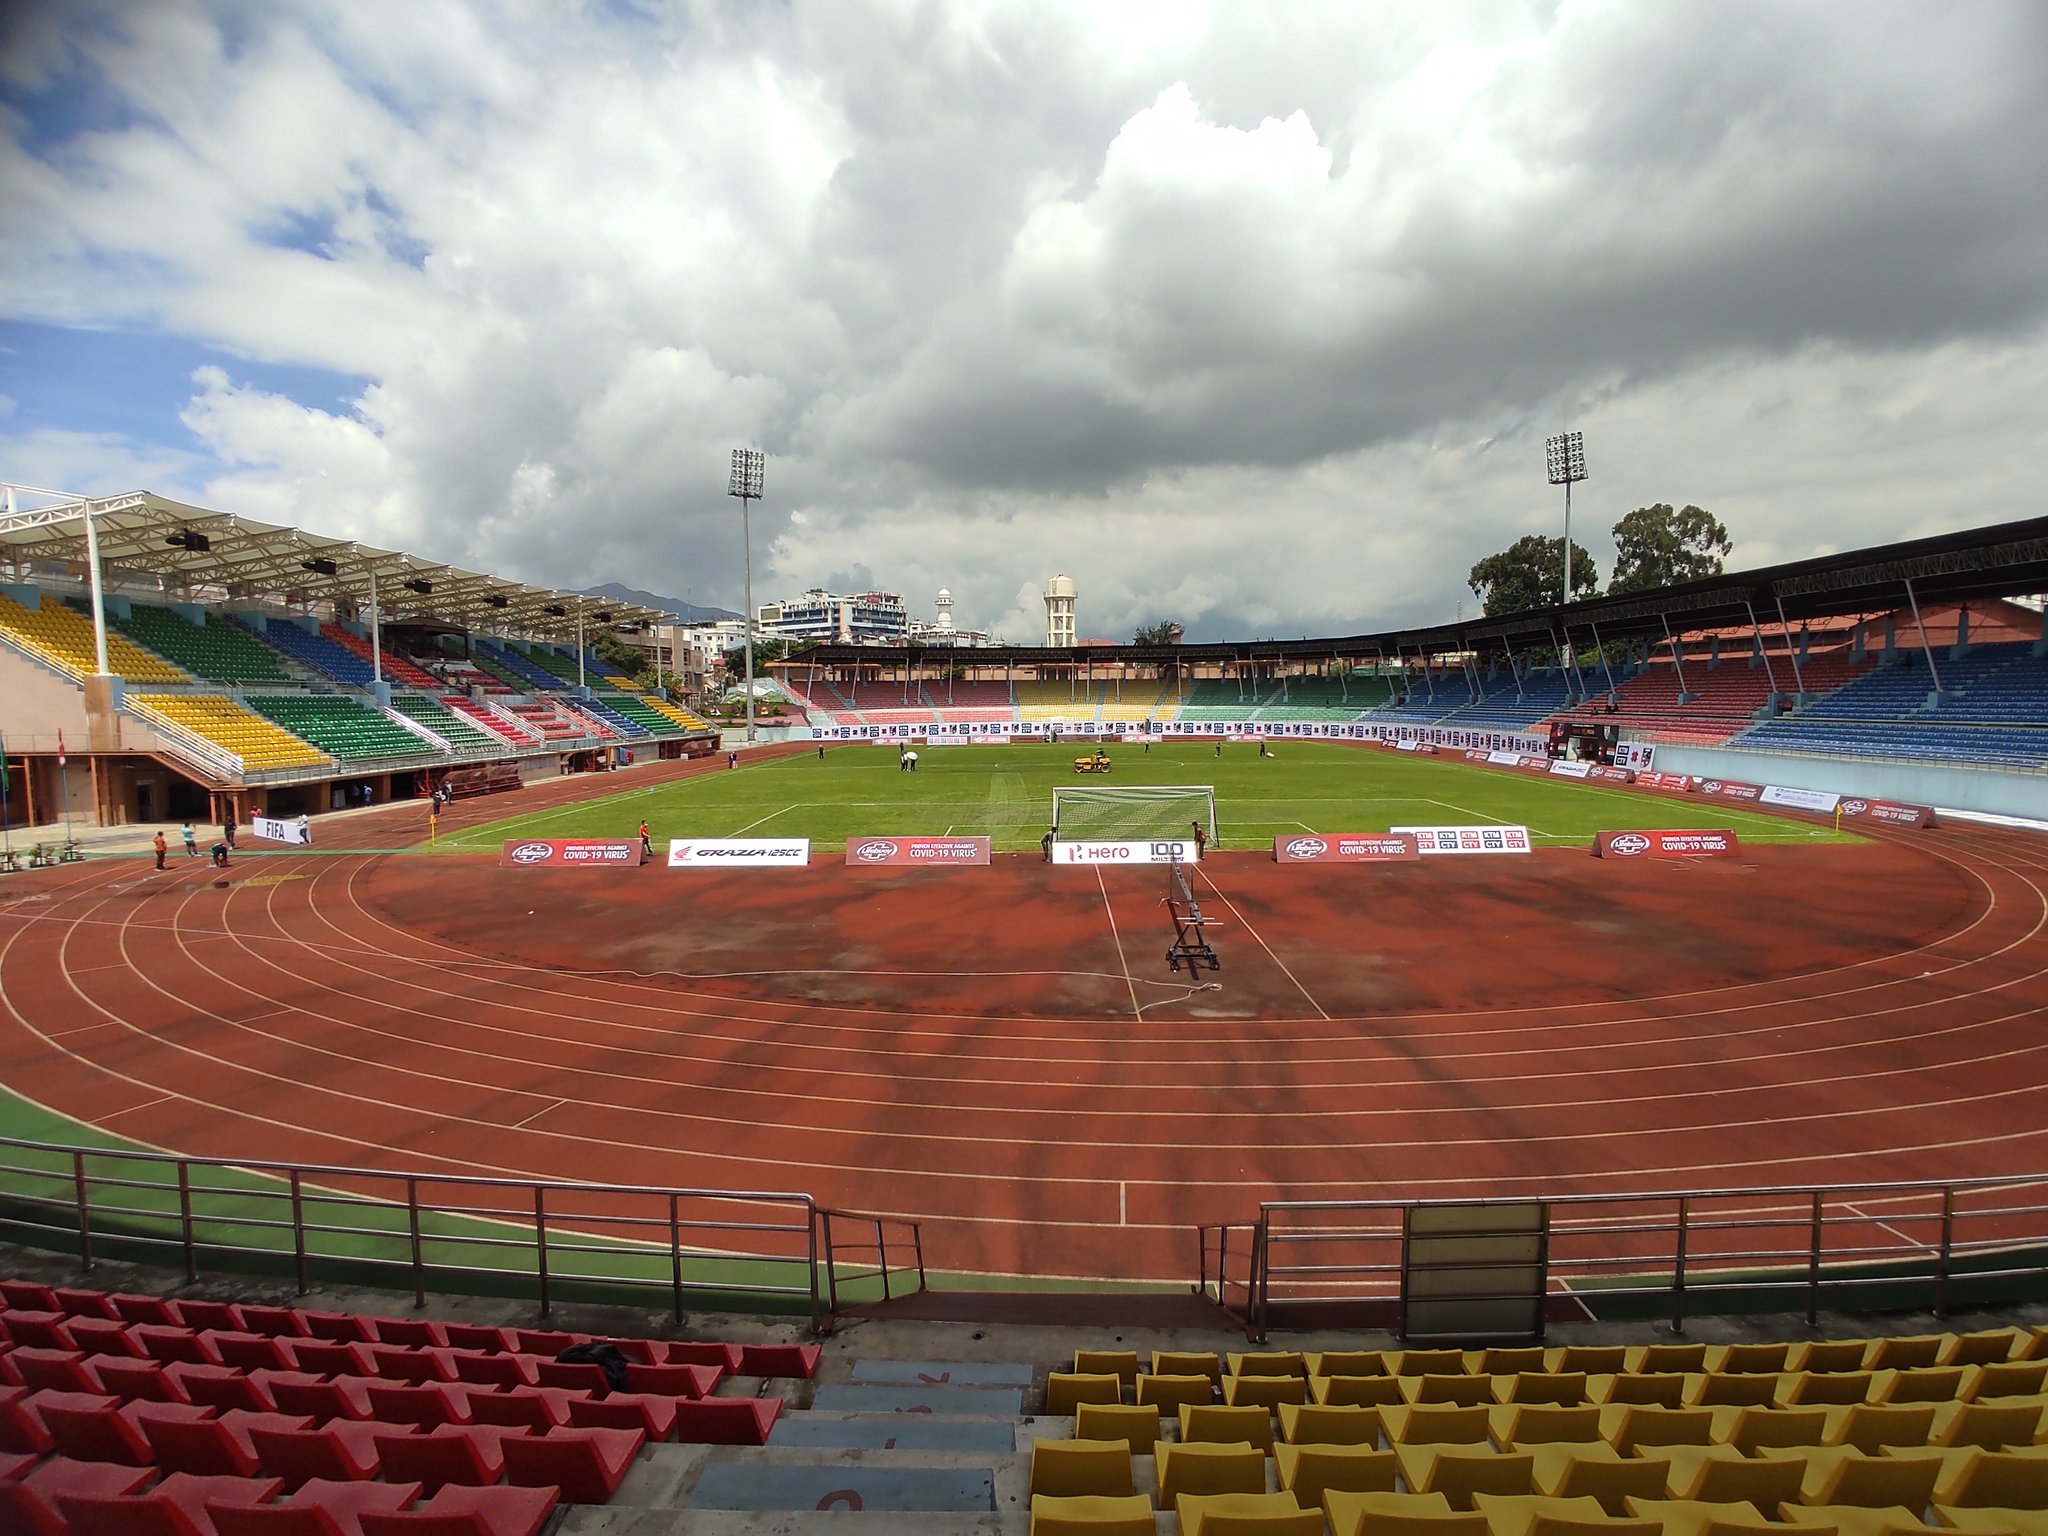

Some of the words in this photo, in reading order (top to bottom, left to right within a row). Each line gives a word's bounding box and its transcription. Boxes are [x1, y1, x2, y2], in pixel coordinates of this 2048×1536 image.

[266, 821, 285, 840] FIFA
[1461, 831, 1478, 839] KTM
[1150, 843, 1184, 855] 100
[1340, 845, 1379, 854] COVID-19
[1662, 842, 1700, 850] COVID-19
[563, 851, 602, 859] COVID-19
[696, 849, 767, 857] GRAZIA
[768, 849, 803, 857] 125CC
[910, 849, 949, 858] COVID-19
[1088, 847, 1130, 858] Hero
